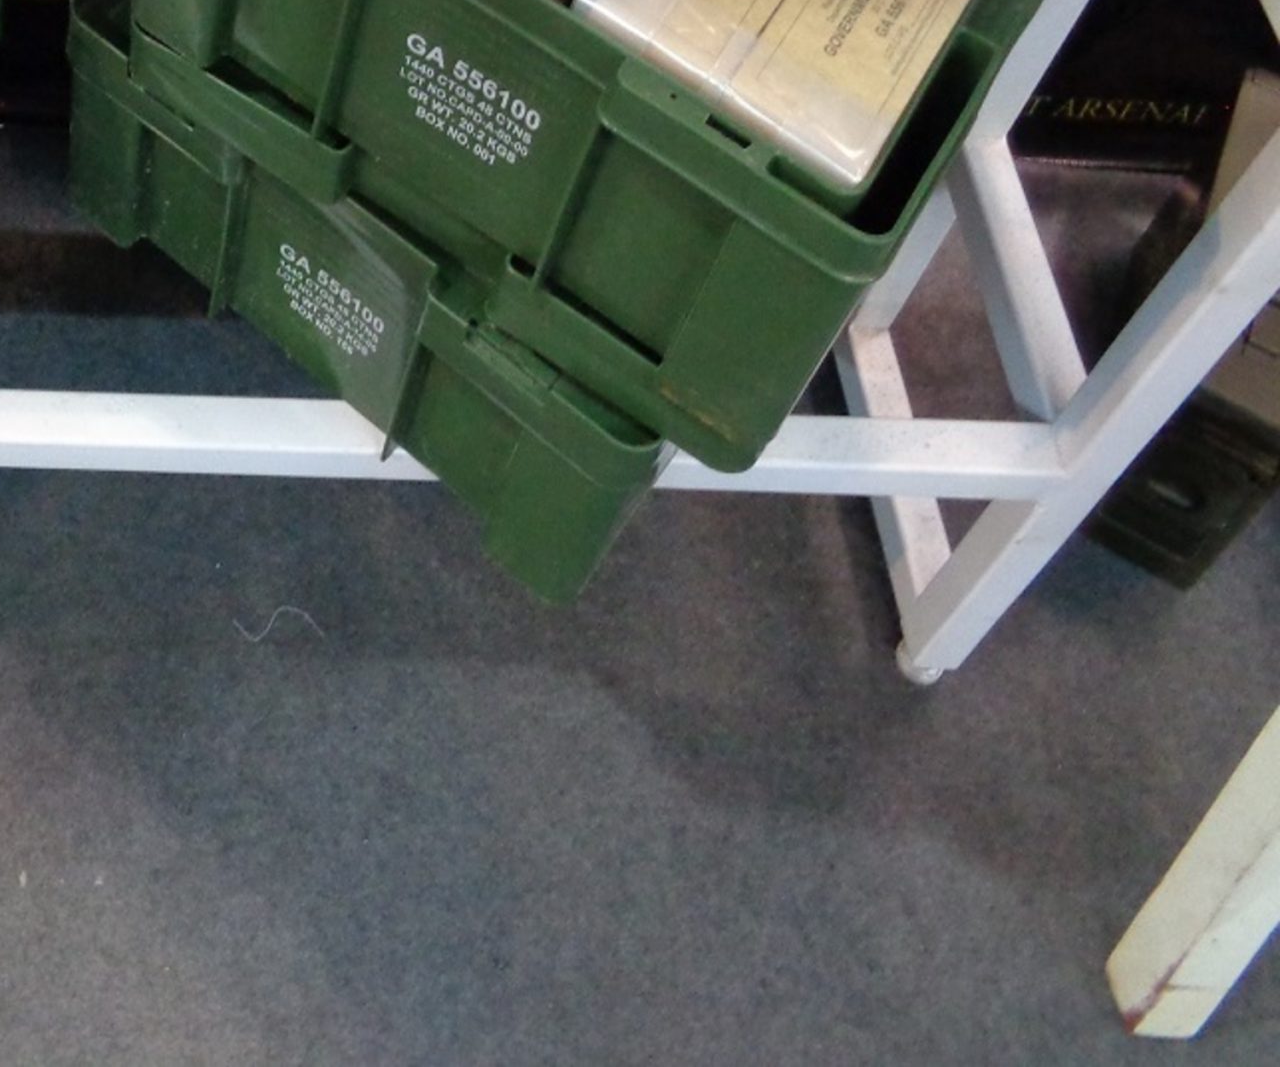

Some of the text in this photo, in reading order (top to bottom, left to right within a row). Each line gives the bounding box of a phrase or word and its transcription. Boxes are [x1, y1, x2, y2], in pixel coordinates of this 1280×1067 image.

[874, 19, 894, 38] GA
[400, 66, 424, 87] LOT
[405, 55, 532, 145] 1440 CTGS 48 CTNS
[407, 34, 541, 131] GA 556100
[408, 86, 429, 105] GR
[458, 117, 486, 142] 20.2
[486, 136, 516, 164] KGS
[415, 106, 445, 131] BOX
[280, 244, 385, 334] GA 556100
